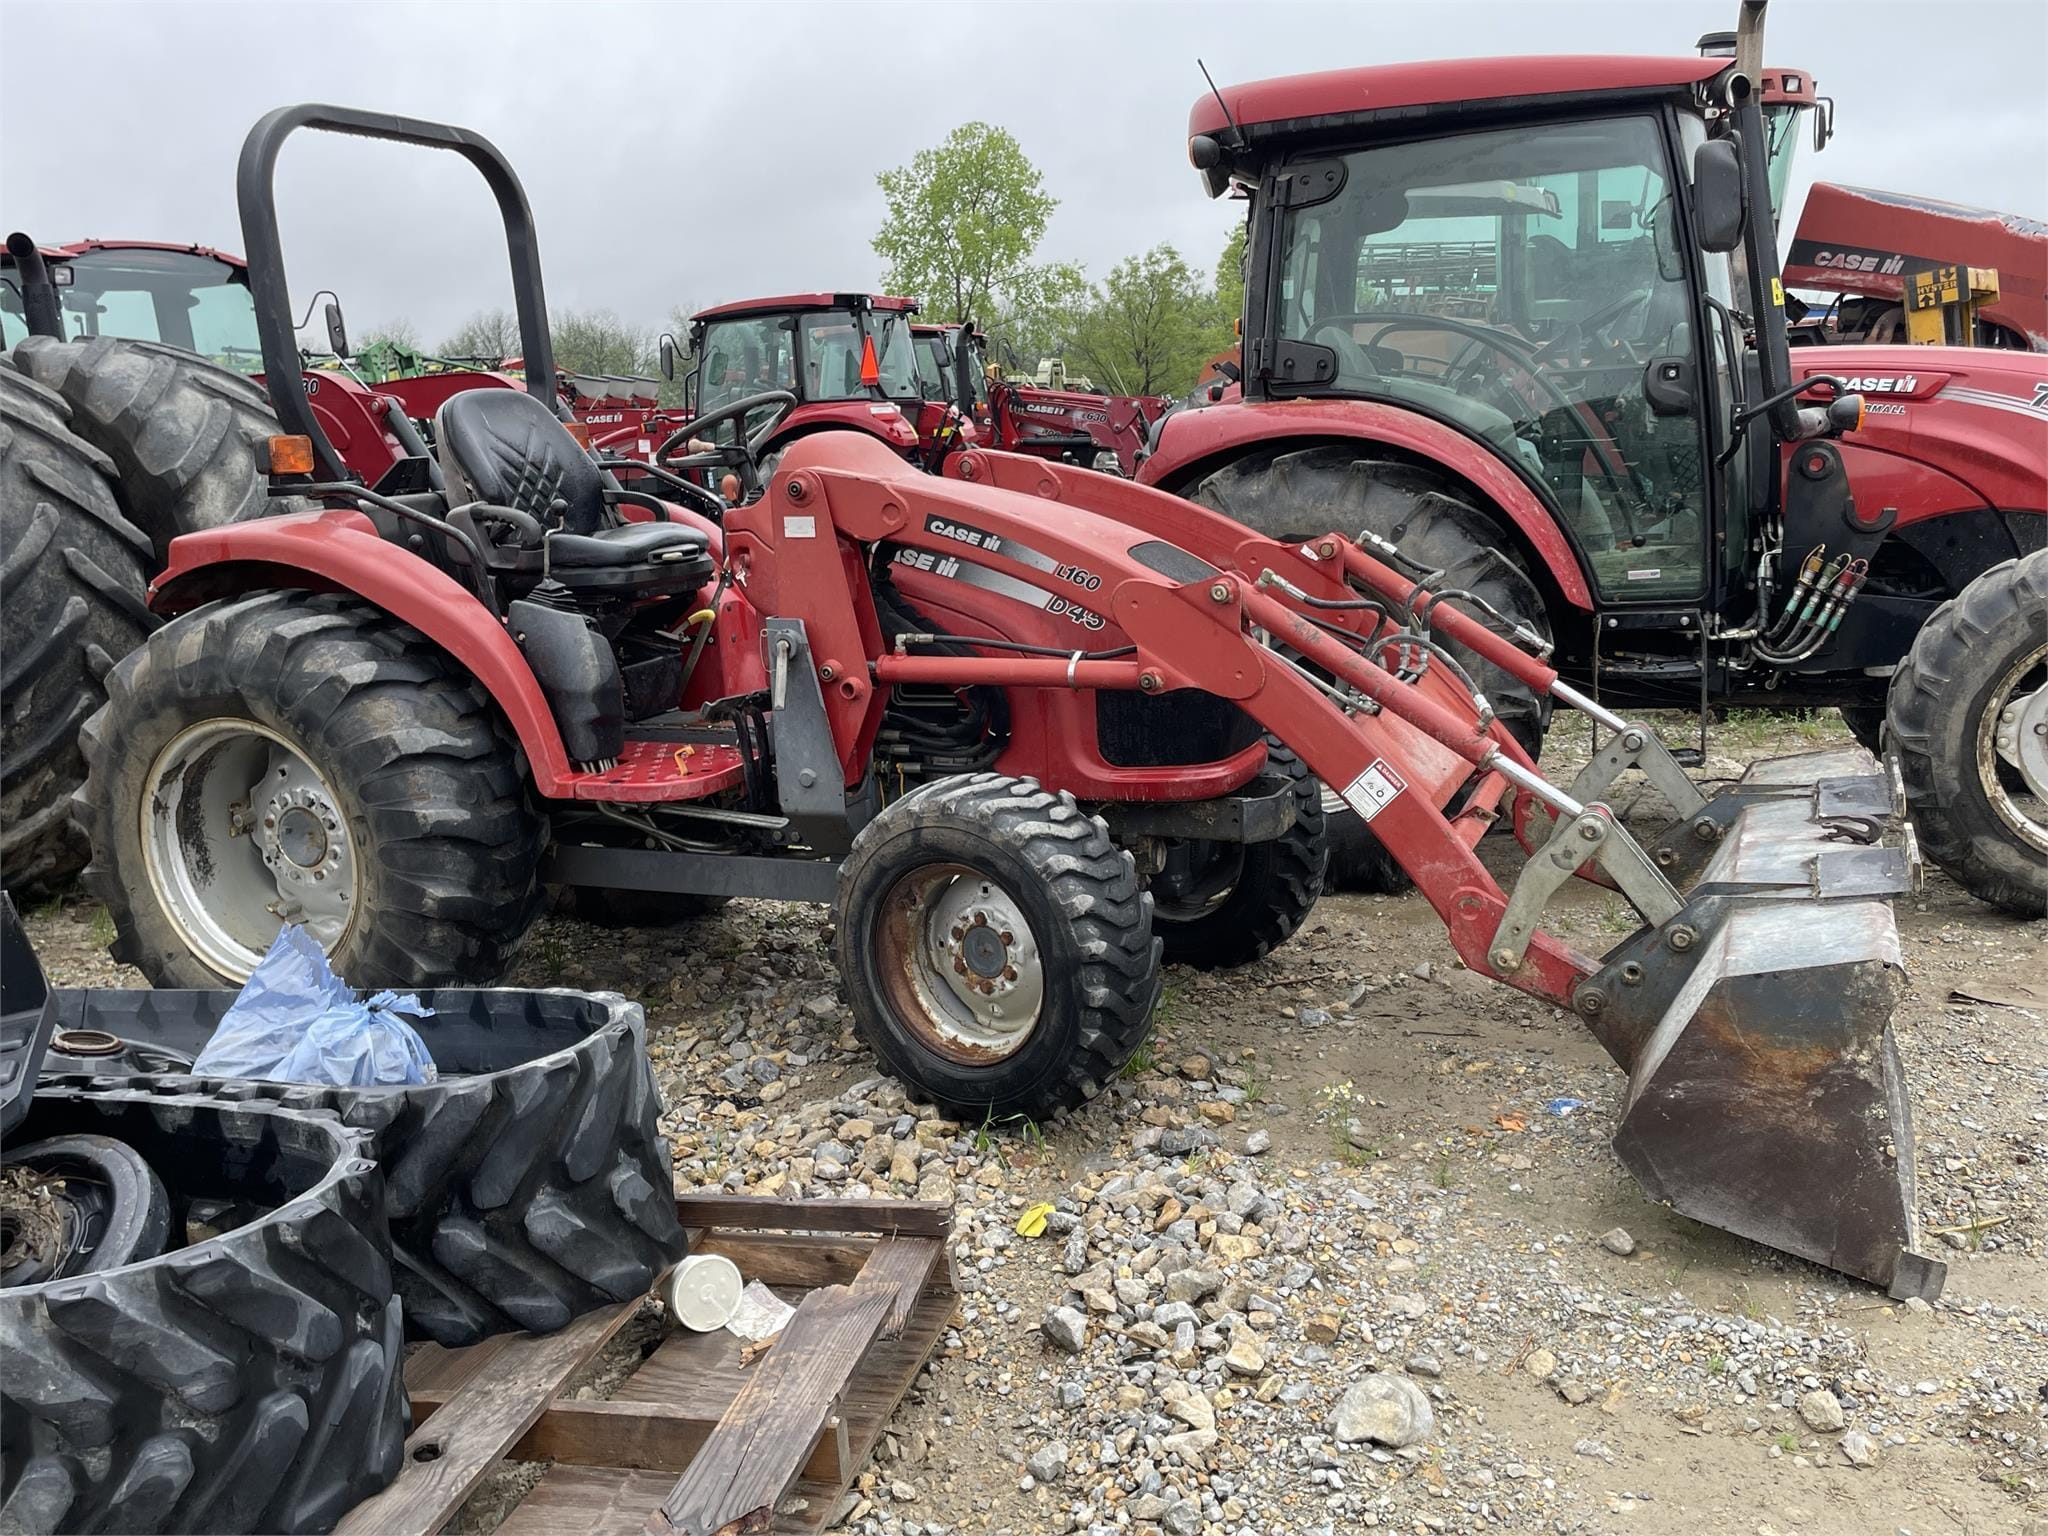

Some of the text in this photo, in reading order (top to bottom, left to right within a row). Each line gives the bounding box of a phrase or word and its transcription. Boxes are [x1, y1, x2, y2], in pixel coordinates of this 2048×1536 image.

[1815, 251, 1879, 272] CASE
[1918, 280, 1958, 295] HYSTER
[586, 415, 613, 424] CASE
[1026, 404, 1054, 414] CASE
[930, 520, 982, 546] CASE
[1055, 564, 1102, 592] L160
[1046, 595, 1105, 630] D45
